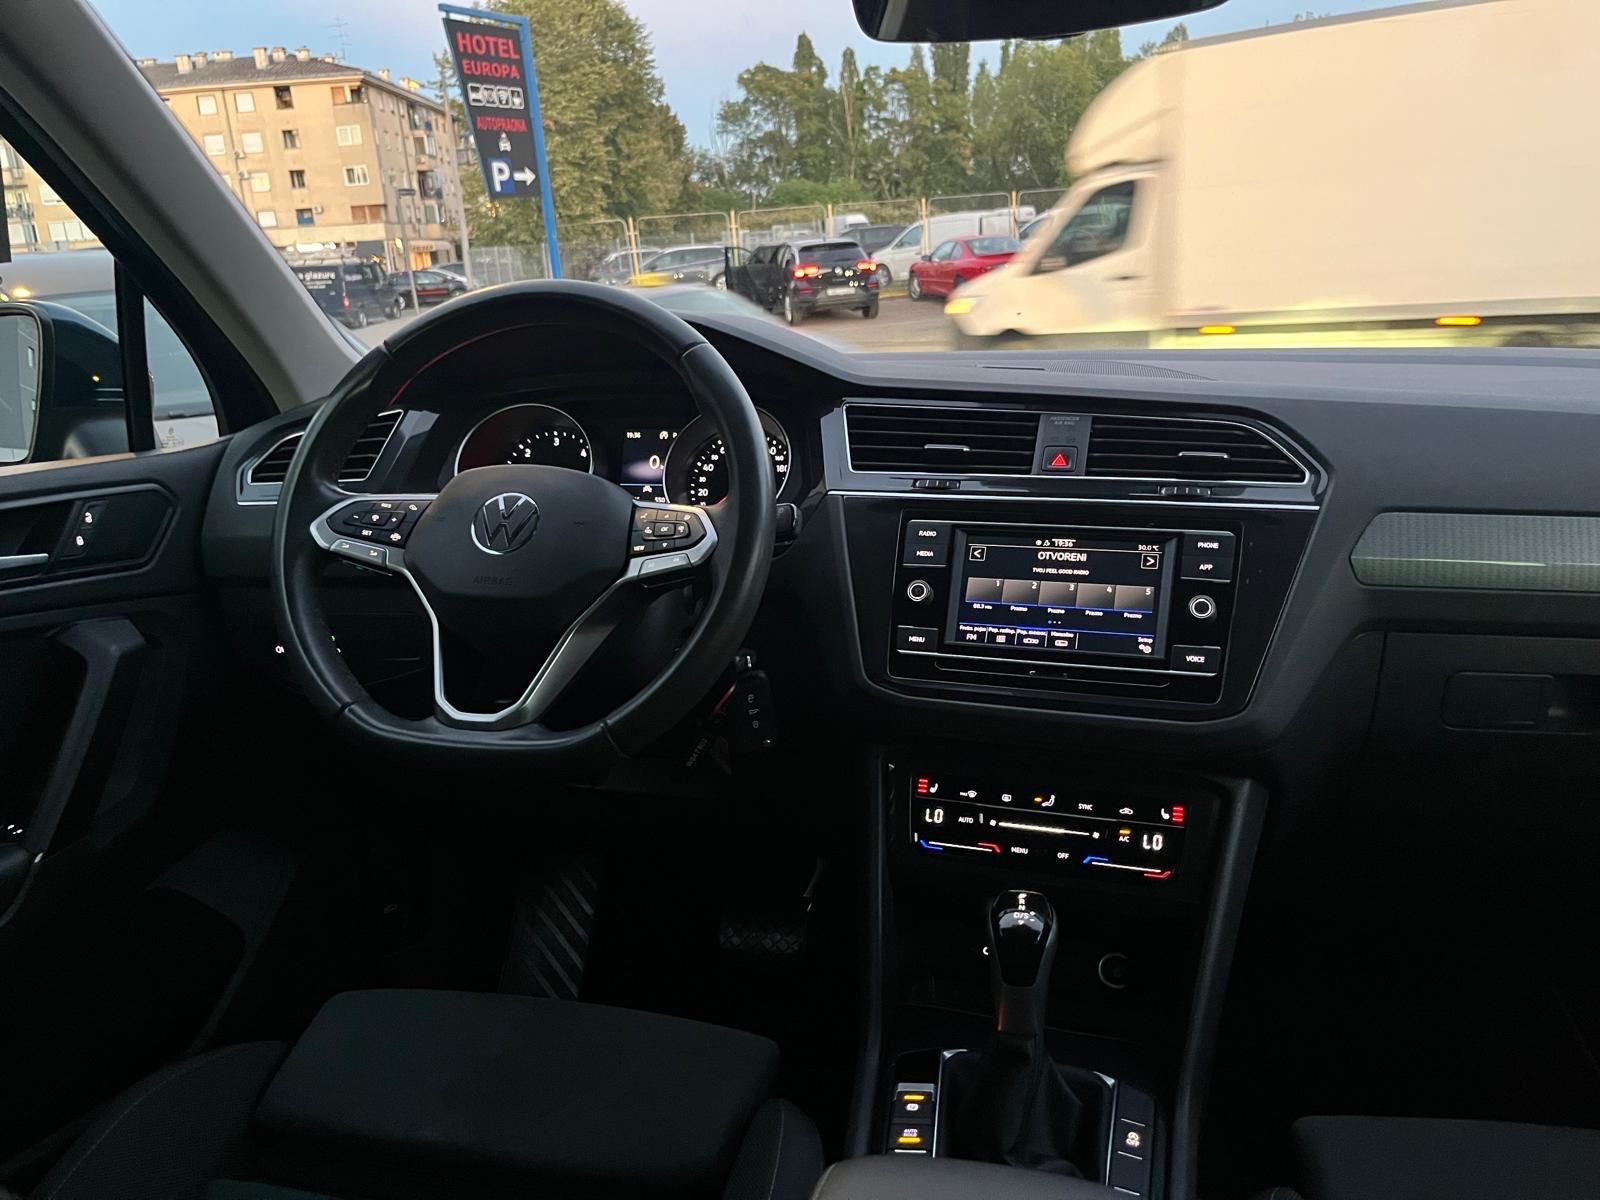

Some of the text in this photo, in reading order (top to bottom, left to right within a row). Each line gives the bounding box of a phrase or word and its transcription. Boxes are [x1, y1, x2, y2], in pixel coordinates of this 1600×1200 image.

[456, 31, 520, 59] HOTEL
[462, 59, 520, 79] EUROPA
[491, 161, 511, 192] P
[553, 437, 560, 447] 3
[524, 448, 532, 458] 2
[580, 449, 588, 458] 4
[649, 455, 660, 469] 0
[703, 463, 715, 472] 40
[697, 488, 709, 497] 20
[361, 529, 373, 537] SET
[1197, 541, 1219, 549] PHONE
[1037, 551, 1088, 562] OTVORENI
[1031, 582, 1038, 590] 2
[1145, 588, 1152, 596] 5
[908, 635, 926, 643] MENU
[1185, 655, 1205, 663] VOICE
[1078, 803, 1093, 811] SYNC
[925, 808, 945, 824] LO
[958, 816, 974, 824] AUTO
[1118, 835, 1130, 843] A/C
[1142, 834, 1164, 851] LO
[1011, 846, 1029, 855] MENU
[1057, 852, 1070, 860] OFF
